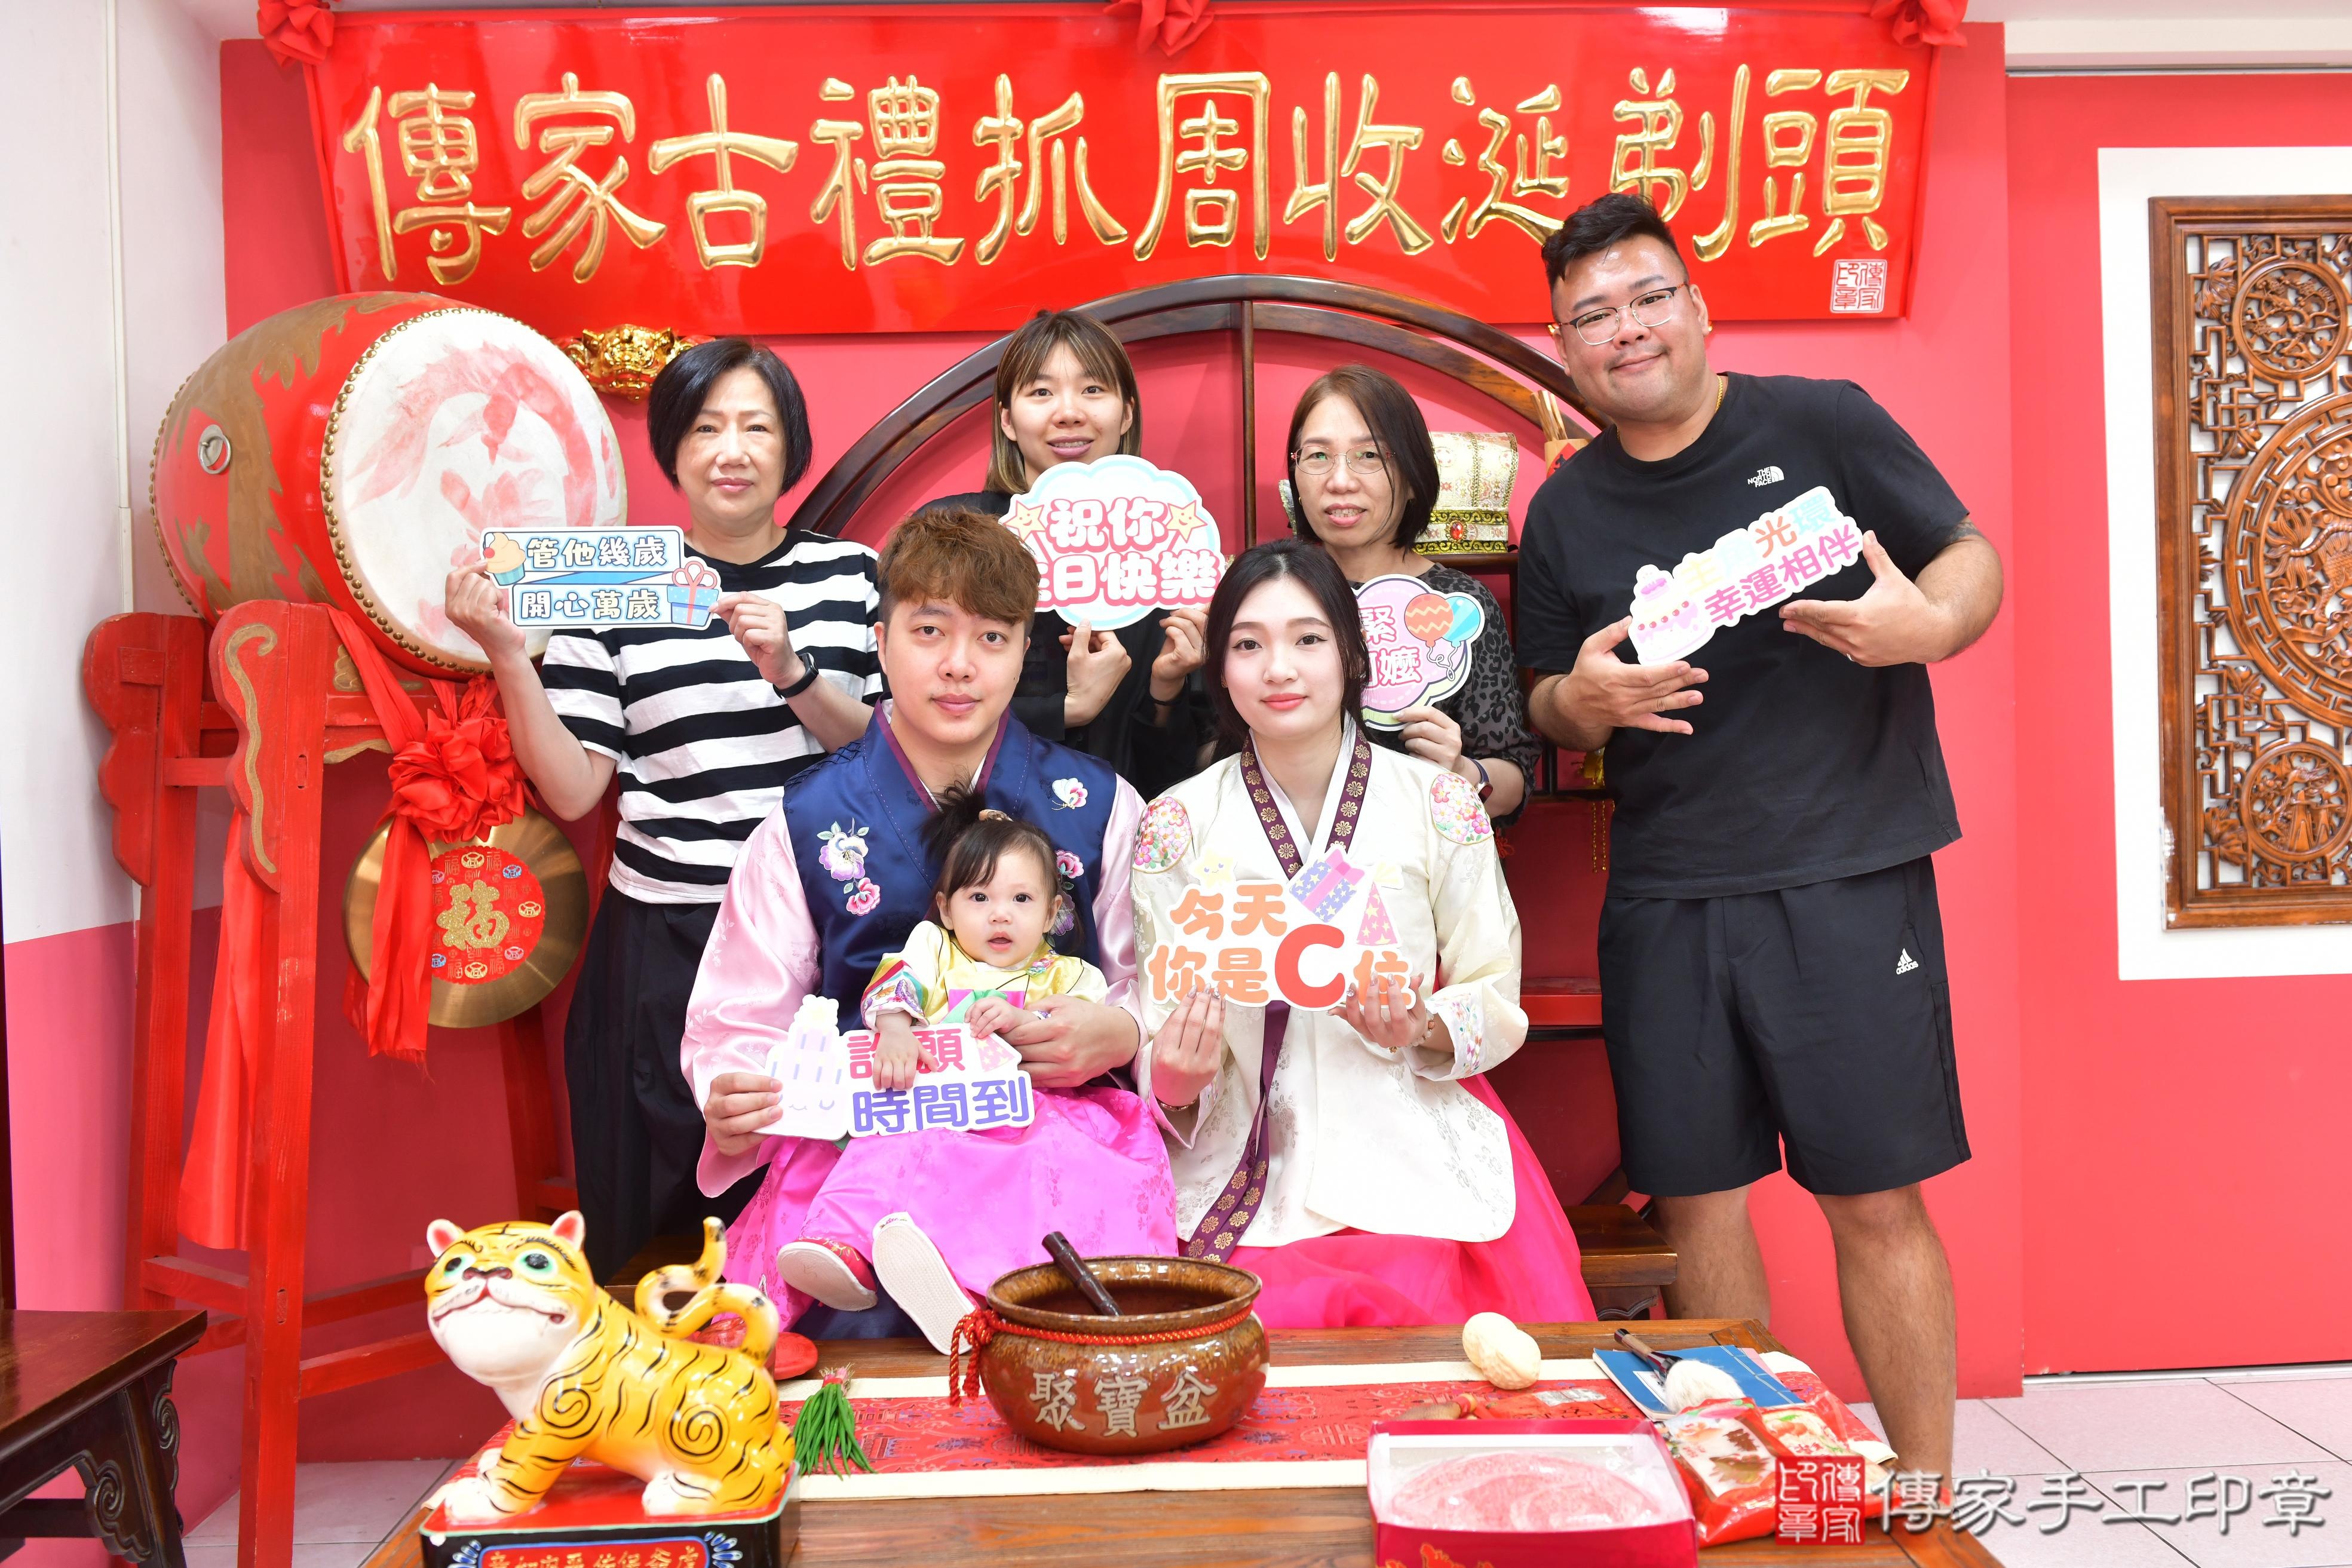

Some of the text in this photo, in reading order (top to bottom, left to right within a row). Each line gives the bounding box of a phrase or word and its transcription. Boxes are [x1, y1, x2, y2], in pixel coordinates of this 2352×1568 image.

[1747, 471, 1771, 484] NORTH
[1755, 478, 1772, 487] FACE
[1756, 467, 1770, 476] THE
[1047, 496, 1169, 554] 祝你
[526, 535, 668, 568] 管他幾歲
[1704, 524, 1859, 623] 幸運相伴
[520, 588, 662, 620] 開心萬歲
[436, 879, 510, 951] 福
[1170, 883, 1287, 941] 今天
[1896, 961, 1919, 975] adidas
[853, 1076, 1029, 1133] 時間到
[1028, 1371, 1218, 1438] 聚寶盆
